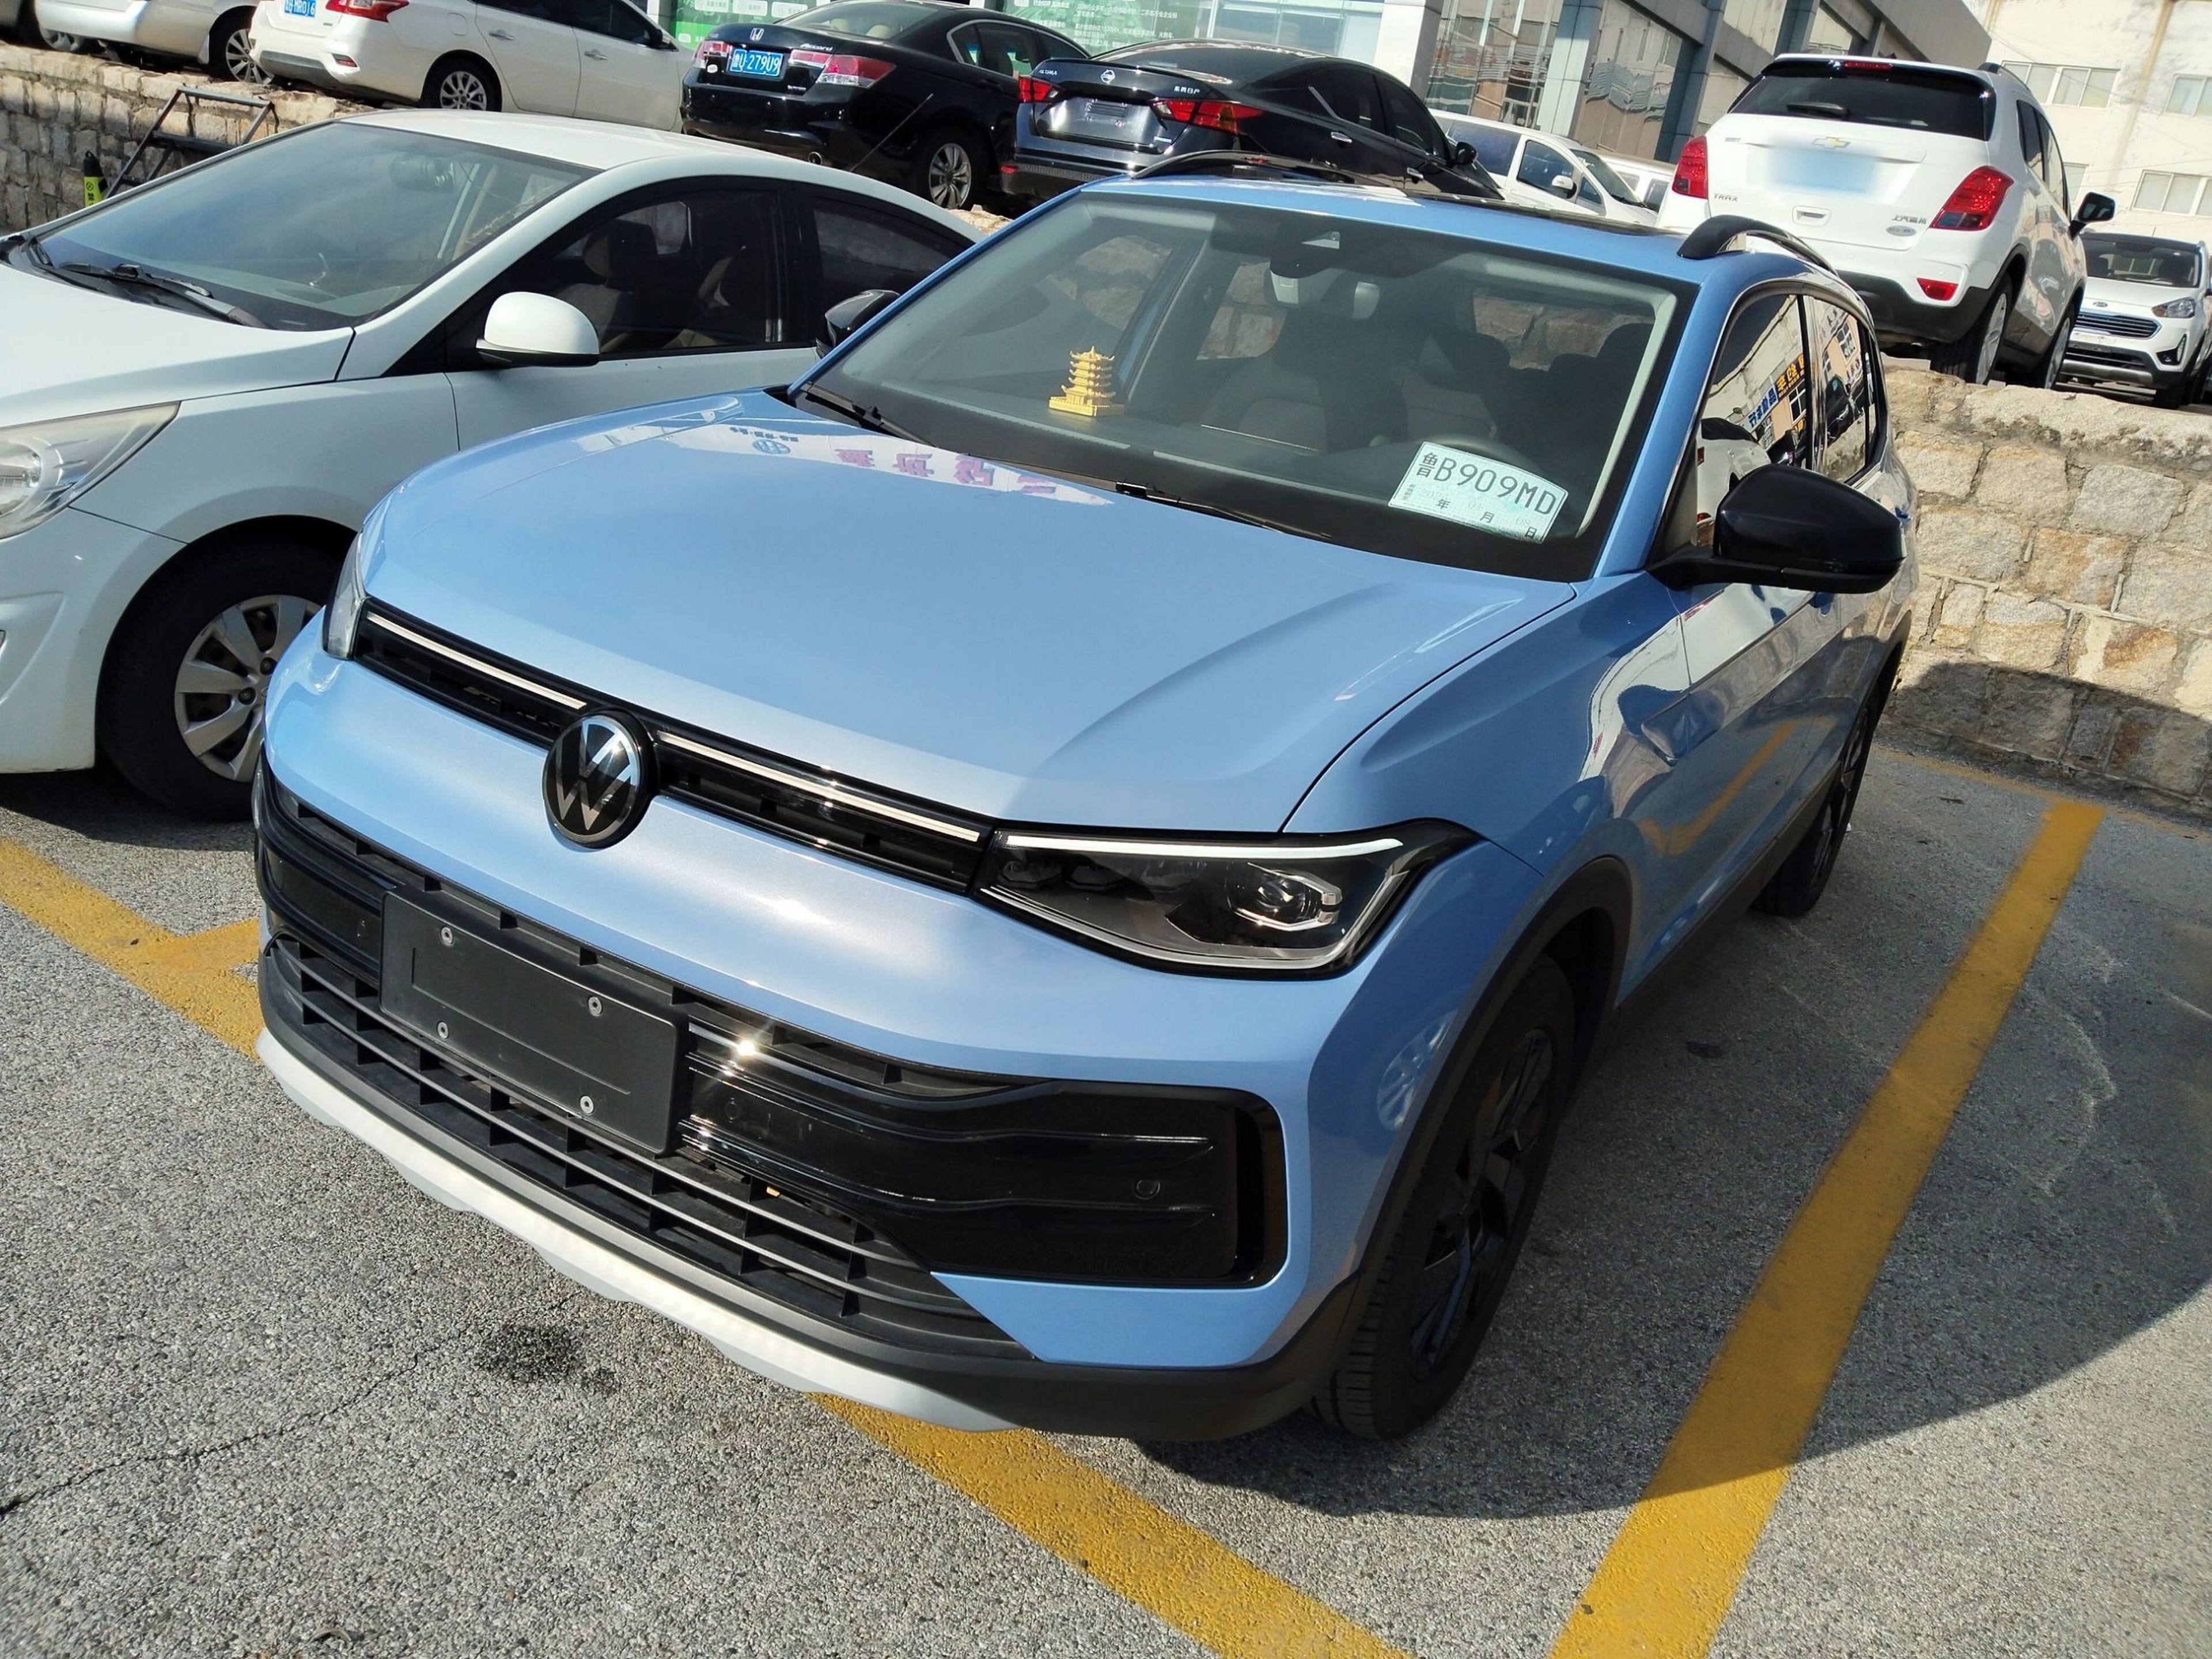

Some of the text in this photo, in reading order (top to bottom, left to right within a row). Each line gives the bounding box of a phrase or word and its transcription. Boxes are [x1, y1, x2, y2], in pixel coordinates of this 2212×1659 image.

[800, 43, 833, 51] Accord
[1416, 452, 1557, 516] 鲁B909MD
[1435, 499, 1450, 510] 年
[1480, 511, 1495, 524] 月
[1525, 526, 1537, 539] 日
